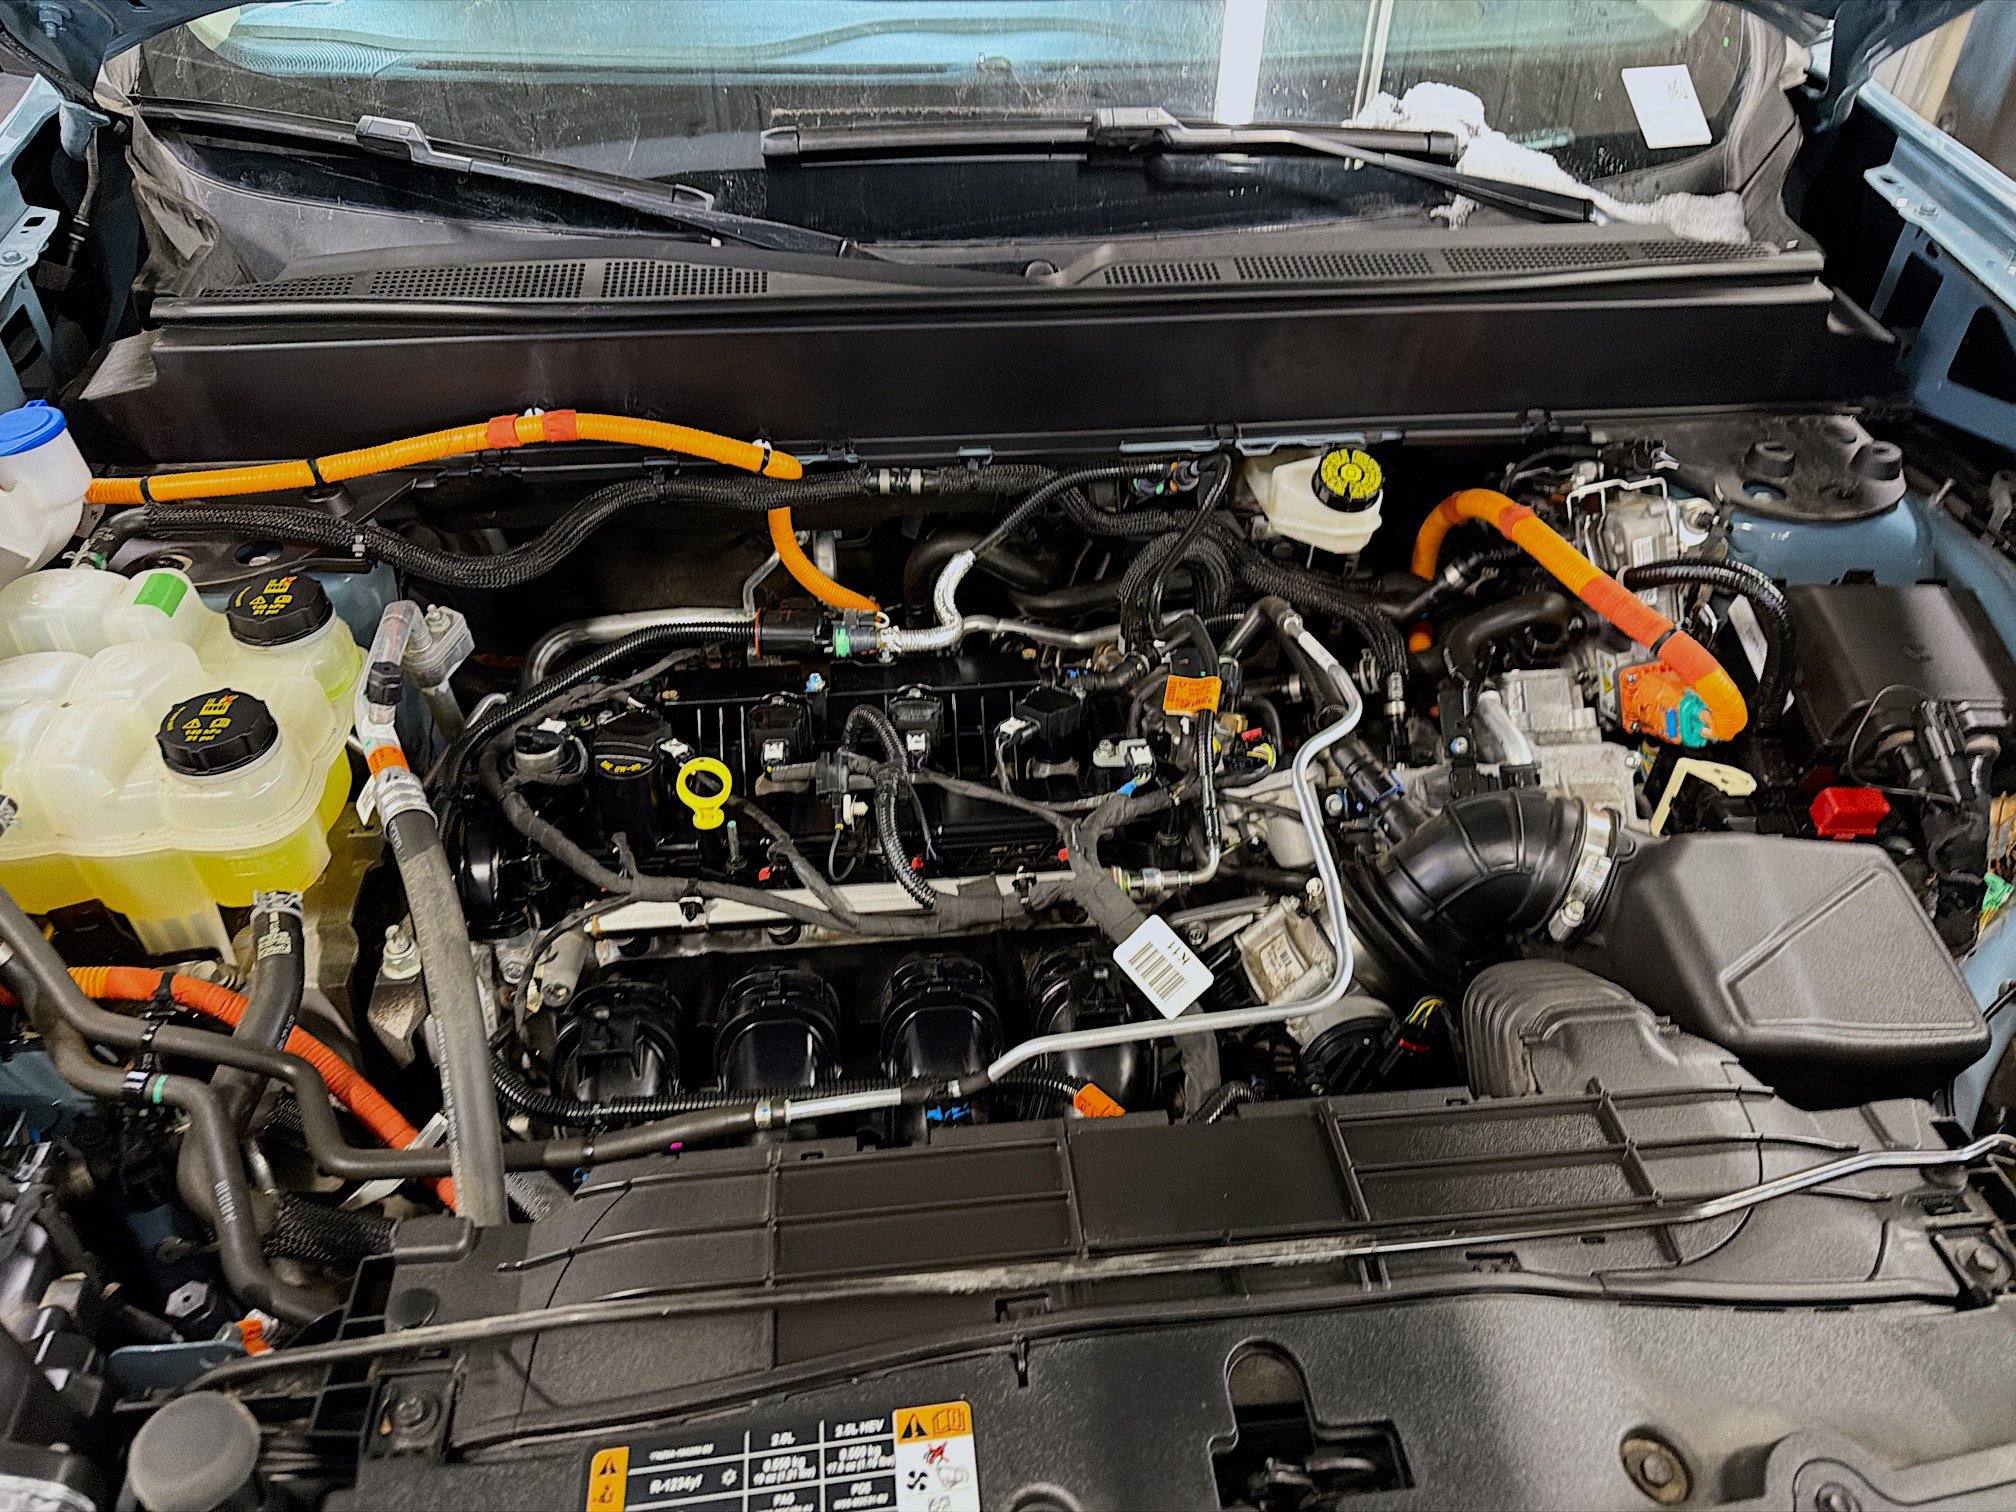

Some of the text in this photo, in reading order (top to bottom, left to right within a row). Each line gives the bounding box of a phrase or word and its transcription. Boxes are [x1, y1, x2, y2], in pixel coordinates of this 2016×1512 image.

[1167, 940, 1191, 966] K11
[834, 1418, 885, 1438] 2.5L HEV
[770, 1431, 796, 1447] 2.0L
[649, 1473, 704, 1495] R-1234yf
